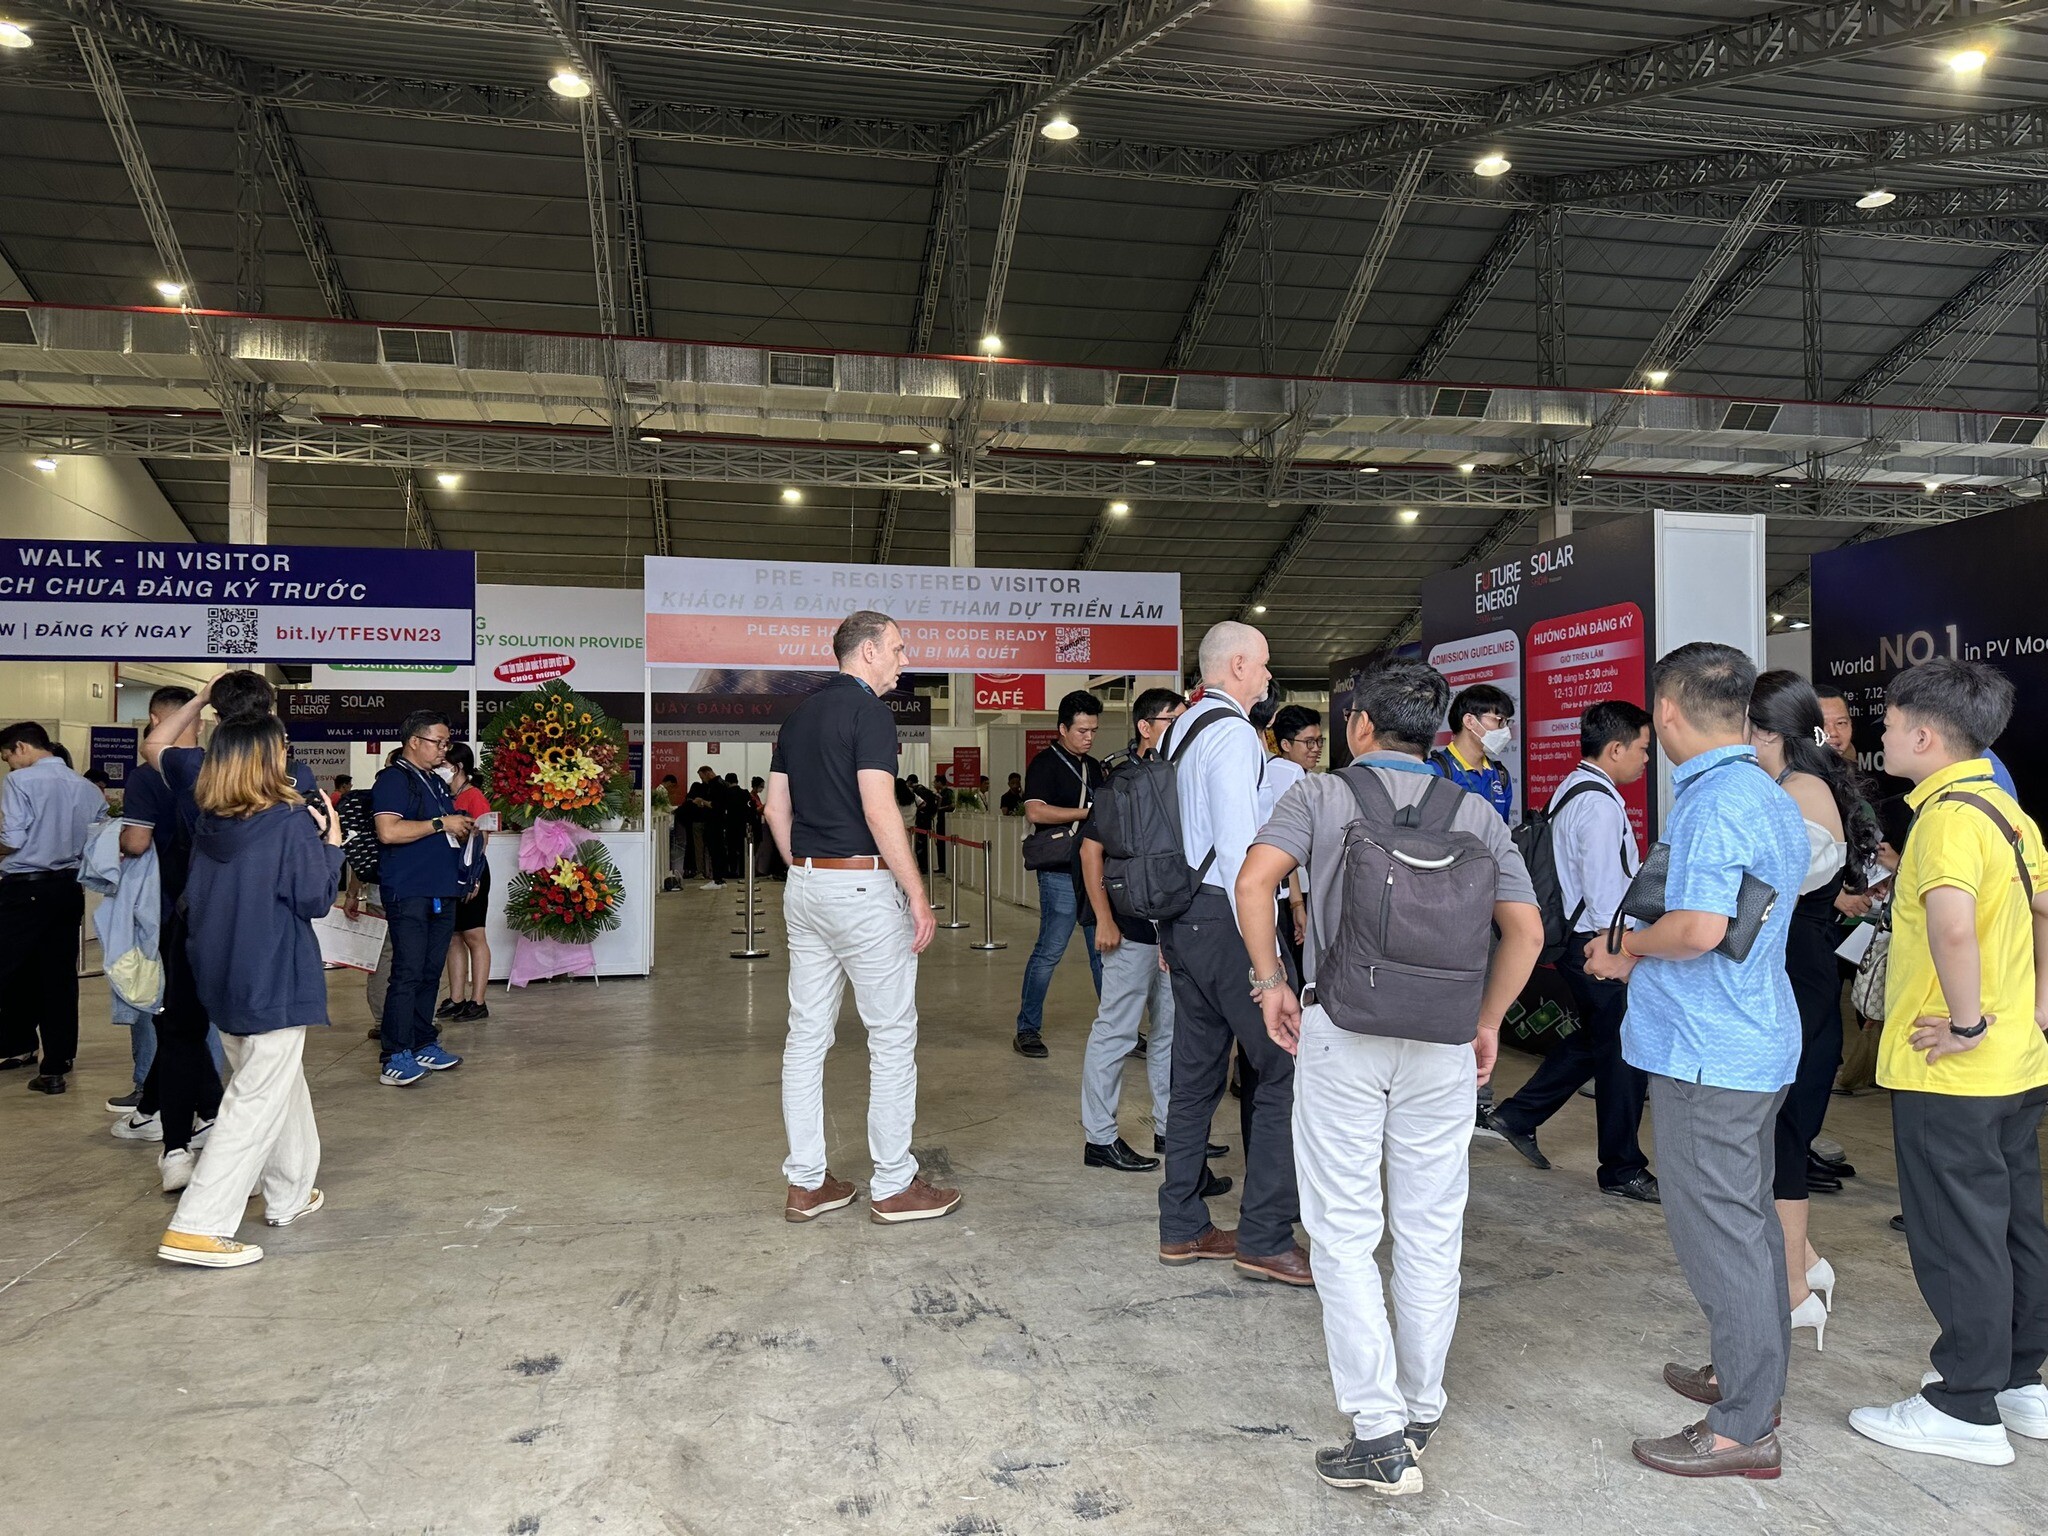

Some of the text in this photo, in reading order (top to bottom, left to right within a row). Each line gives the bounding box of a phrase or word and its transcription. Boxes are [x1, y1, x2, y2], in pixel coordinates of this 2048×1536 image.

[19, 548, 103, 568] WALK
[137, 551, 165, 569] IN
[177, 551, 290, 571] VISITOR
[1475, 544, 1574, 593] FUTURE SOLAR
[45, 577, 126, 596] CHƯA
[136, 575, 213, 598] ĐĂNG
[223, 577, 260, 598] KÝ
[269, 578, 367, 600] TRƯỚC
[755, 568, 803, 586] PRE
[831, 571, 981, 591] REGISTERED
[990, 576, 1081, 593] VISITOR
[661, 588, 1164, 620] KHÁCH ĐÃ ĐĂNG KÝ VÉ THAM DỰ TRIỂN LÃM
[1475, 583, 1520, 614] ENERGY
[35, 620, 94, 637] ĐĂNG
[101, 621, 129, 637] KÝ
[135, 625, 192, 639] NGAY
[276, 625, 442, 643] bit.ly/TFESVN23
[747, 623, 811, 637] PLEASE
[817, 625, 837, 638] HA
[917, 627, 940, 642] QR
[946, 629, 989, 641] CODE
[995, 630, 1048, 642] READY
[1533, 628, 1567, 645] HƯỚNG
[1589, 618, 1617, 635] ĐĂNG
[1619, 611, 1634, 629] KÝ
[498, 634, 575, 648] SOLUTION
[579, 636, 644, 649] PROVIDE
[778, 643, 806, 656] VUI
[811, 641, 835, 657] LÒ
[926, 647, 942, 660] BỊ
[947, 645, 970, 659] MÃ
[976, 645, 1020, 660] QUÉT
[1830, 655, 1874, 677] World
[1879, 624, 1958, 671] NO.1
[1964, 642, 1981, 661] in
[1986, 638, 2010, 659] PV
[1431, 640, 1515, 666] ADMISSION GUIDELINES
[510, 673, 534, 683] CHÚC
[1450, 669, 1494, 684] EXHIBITION HOURS
[1547, 673, 1563, 685] 9:00
[1585, 668, 1601, 680] 5:30
[976, 688, 1024, 706] CAFÉ
[1553, 686, 1573, 699] 12-13
[1578, 684, 1588, 696] 07
[1593, 681, 1613, 695] 2023
[1864, 687, 1888, 700] 7.12-
[289, 705, 329, 714] ENERGY
[340, 695, 385, 708] SOLAR
[327, 728, 353, 736] WALK
[376, 728, 402, 736] VISIT
[633, 729, 645, 737] PR
[657, 729, 707, 737] REGISTERED
[370, 742, 377, 753] 1
[710, 743, 719, 754] 5
[1857, 750, 1886, 772] MO
